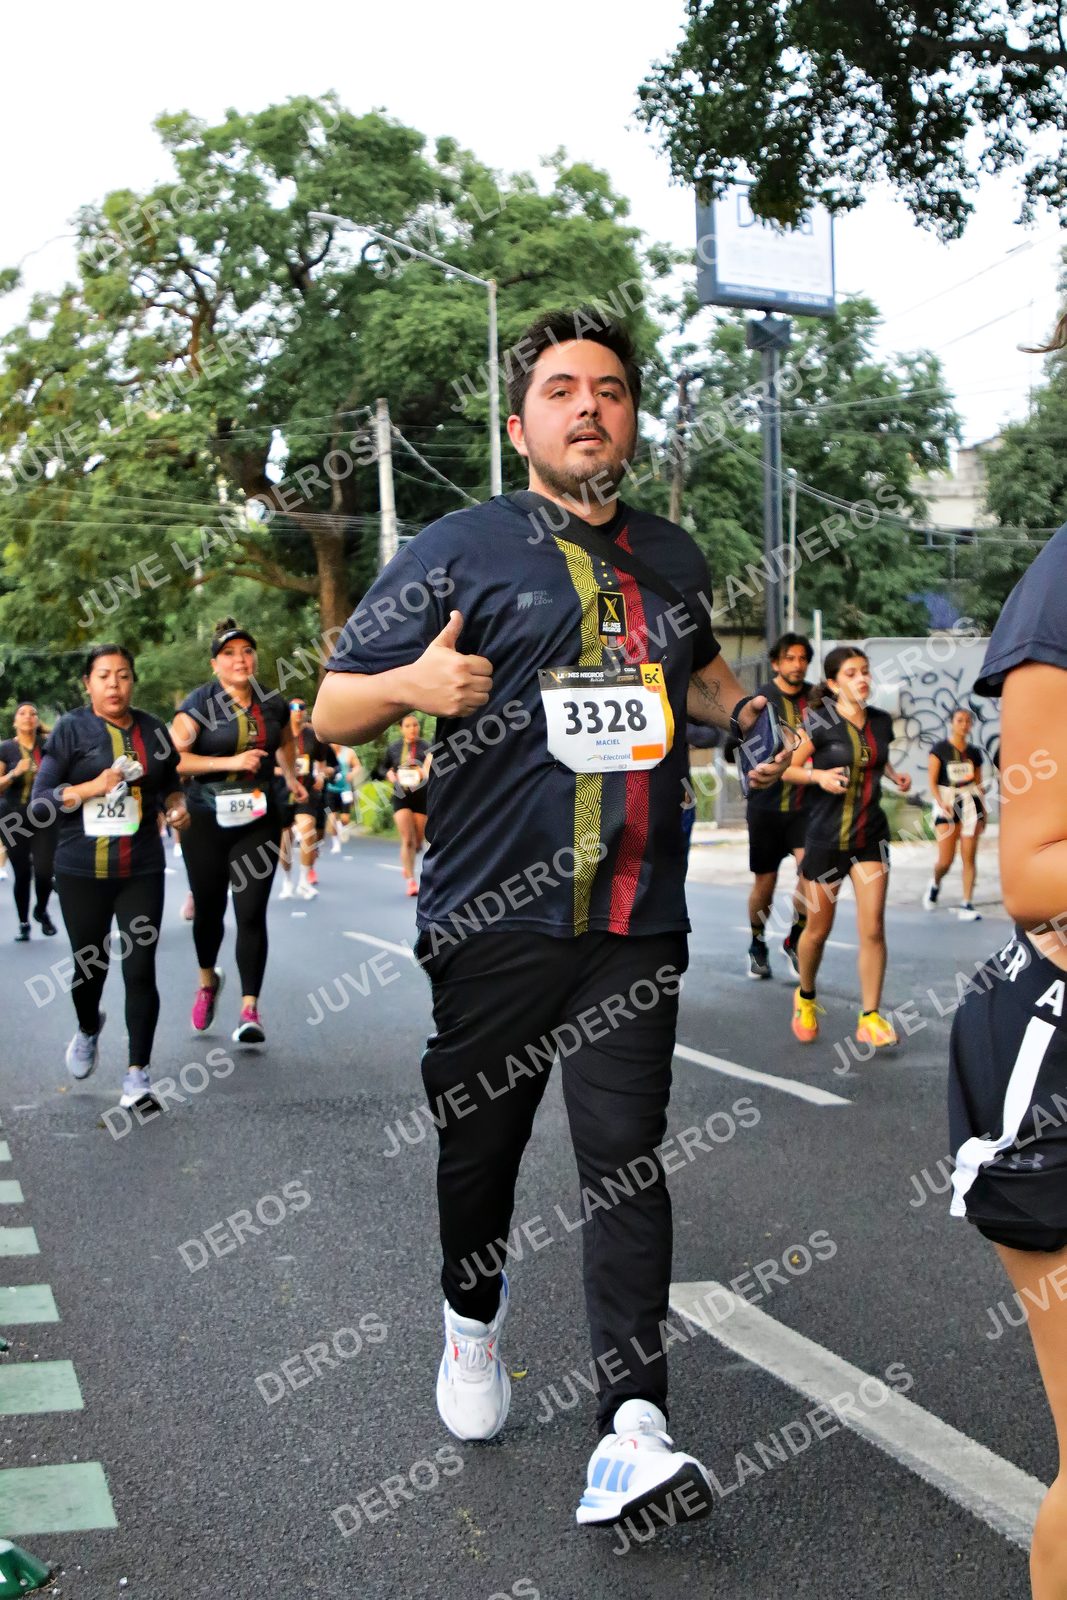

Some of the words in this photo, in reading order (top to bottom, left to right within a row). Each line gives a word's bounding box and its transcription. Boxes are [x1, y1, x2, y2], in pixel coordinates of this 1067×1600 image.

[645, 673, 660, 684] 5K
[563, 699, 647, 735] 3328
[230, 798, 254, 812] 894
